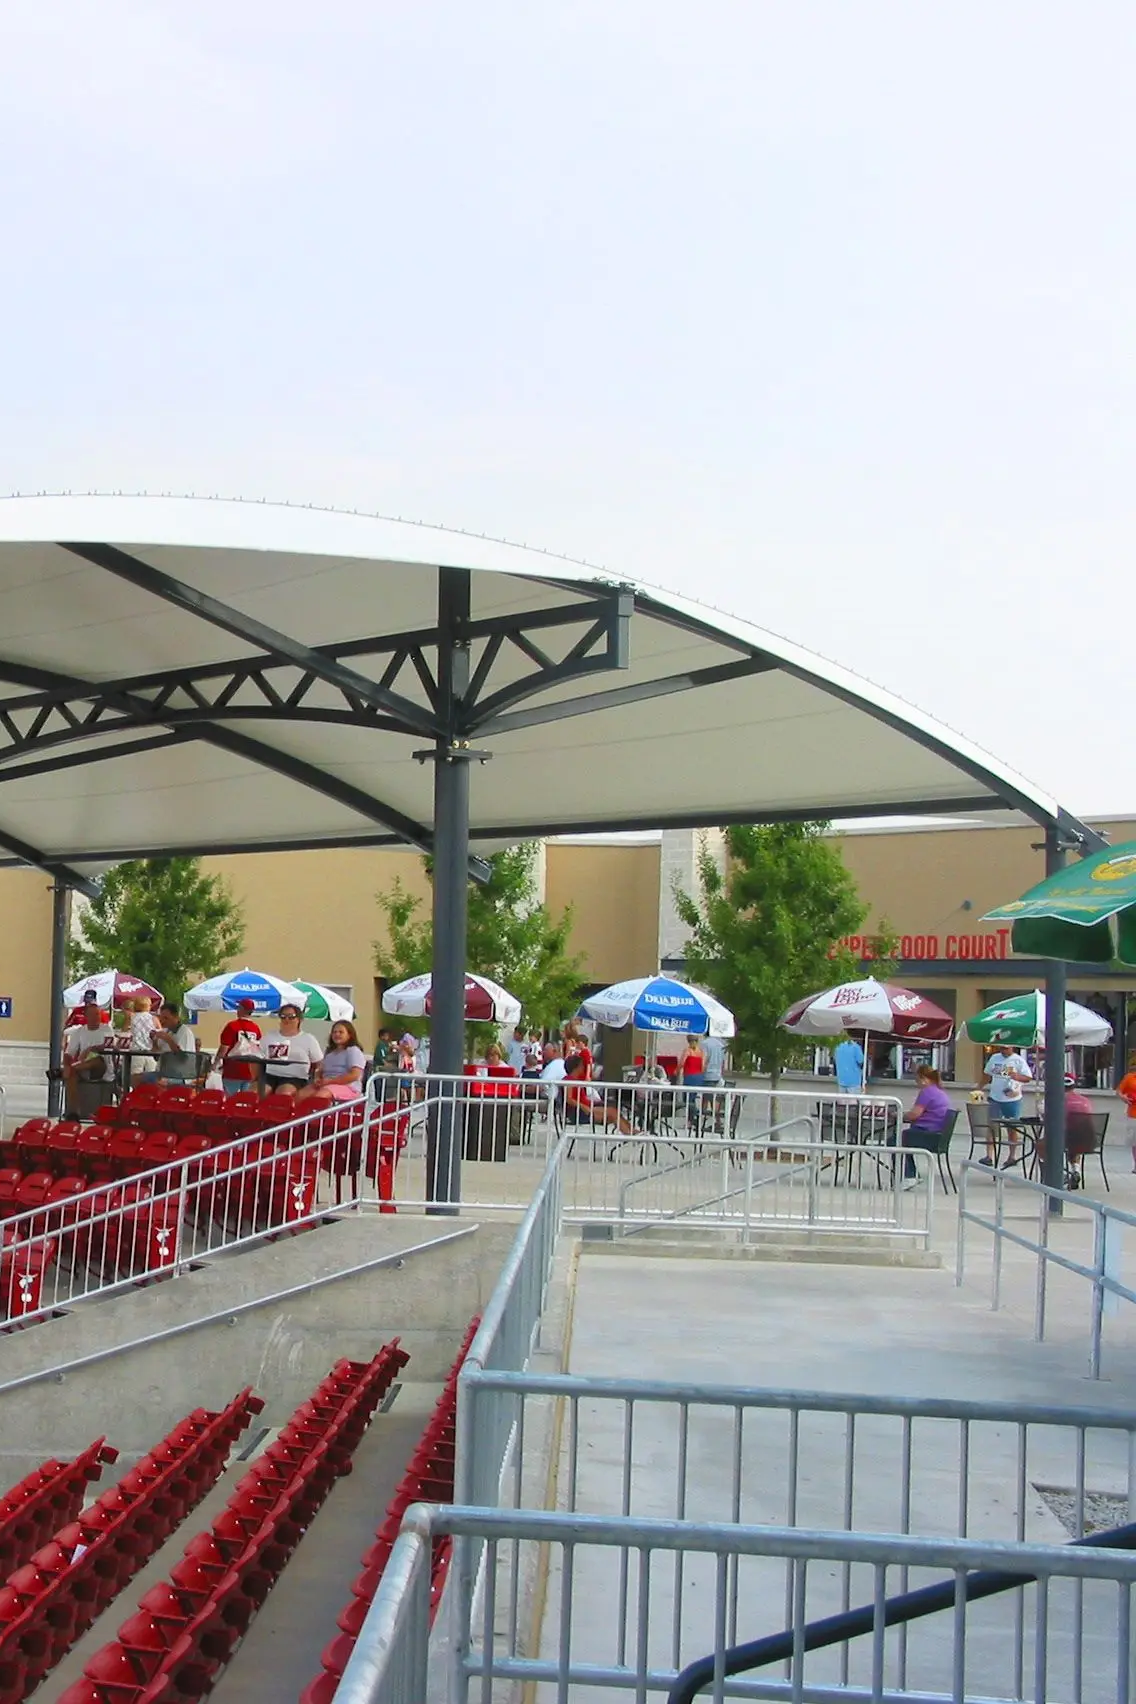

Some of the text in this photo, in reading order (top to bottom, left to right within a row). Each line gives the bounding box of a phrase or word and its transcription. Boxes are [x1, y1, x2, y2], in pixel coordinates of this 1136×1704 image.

[946, 928, 1009, 960] COURT
[644, 994, 670, 1007] DEJA
[670, 995, 695, 1006] BLUE
